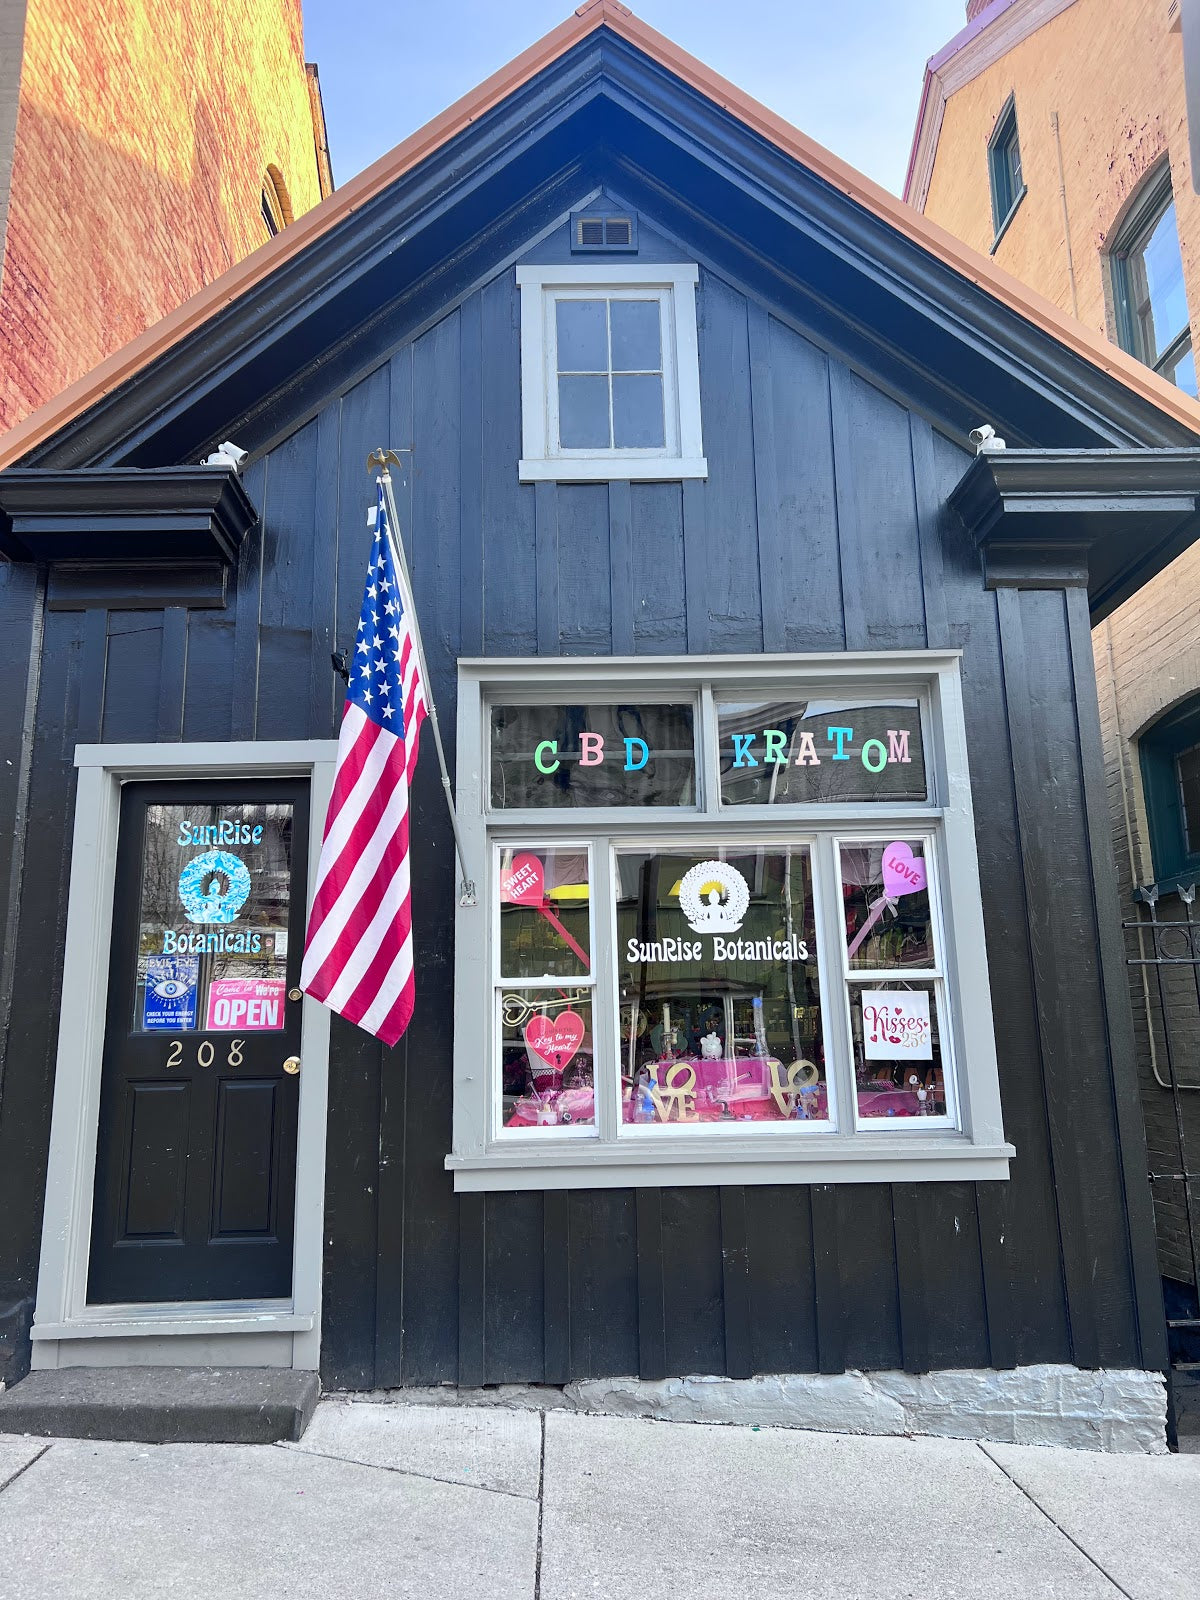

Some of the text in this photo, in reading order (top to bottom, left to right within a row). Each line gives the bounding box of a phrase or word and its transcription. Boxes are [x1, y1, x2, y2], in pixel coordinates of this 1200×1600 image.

[731, 726, 912, 773] KRATOM
[177, 819, 264, 847] SunRise
[503, 863, 533, 891] SWEET
[888, 857, 921, 885] LOVE
[510, 872, 539, 899] HEART
[162, 929, 262, 954] Botanicals
[626, 933, 808, 962] SunRise Botanicals
[216, 983, 279, 996] Come in We're
[213, 998, 279, 1026] OPEN
[863, 1005, 923, 1042] Kisses
[166, 1039, 246, 1067] 208
[534, 1033, 579, 1049] Key to my
[544, 1042, 573, 1056] Heart
